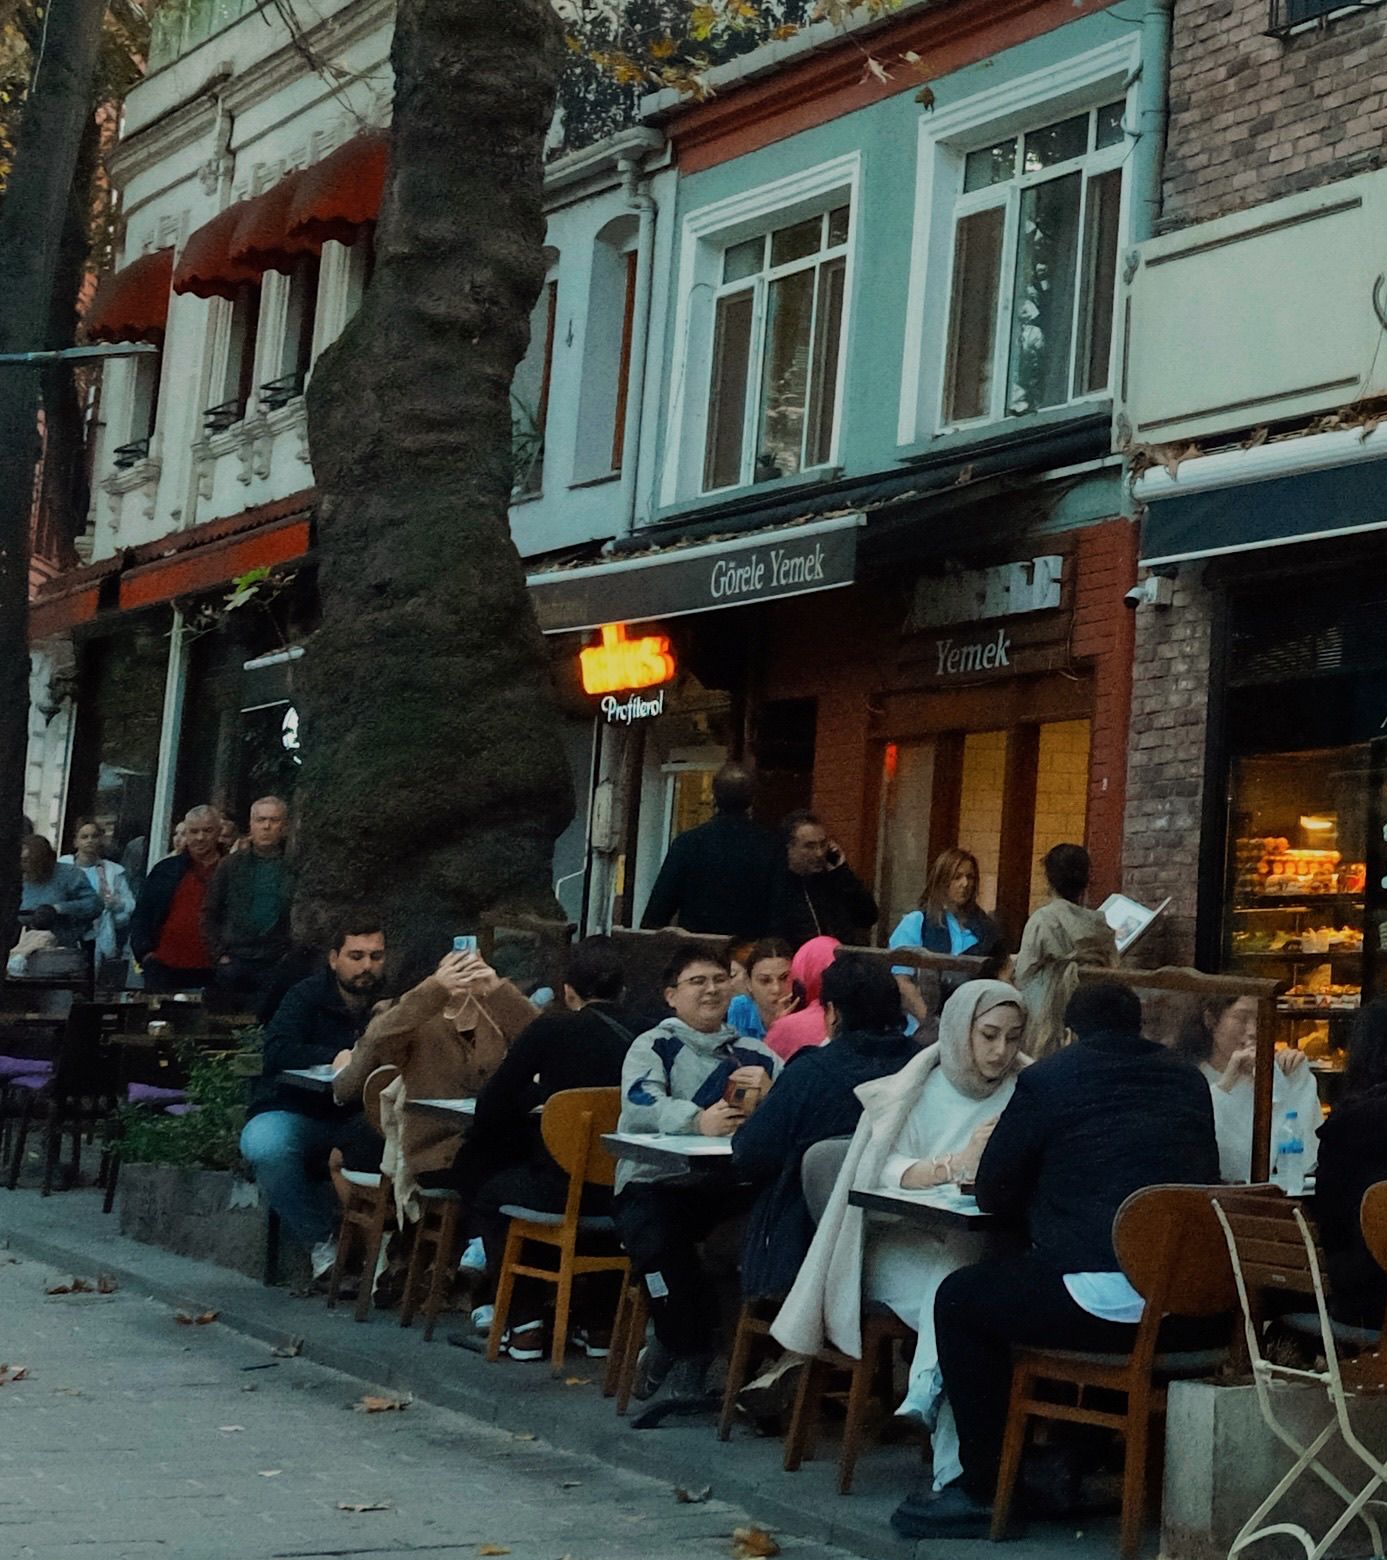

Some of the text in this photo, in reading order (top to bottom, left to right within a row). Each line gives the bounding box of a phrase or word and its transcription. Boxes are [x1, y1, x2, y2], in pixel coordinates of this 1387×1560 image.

[711, 543, 825, 598] Görele Yemek
[935, 628, 1011, 676] Yemek
[601, 690, 664, 727] Profiterol
